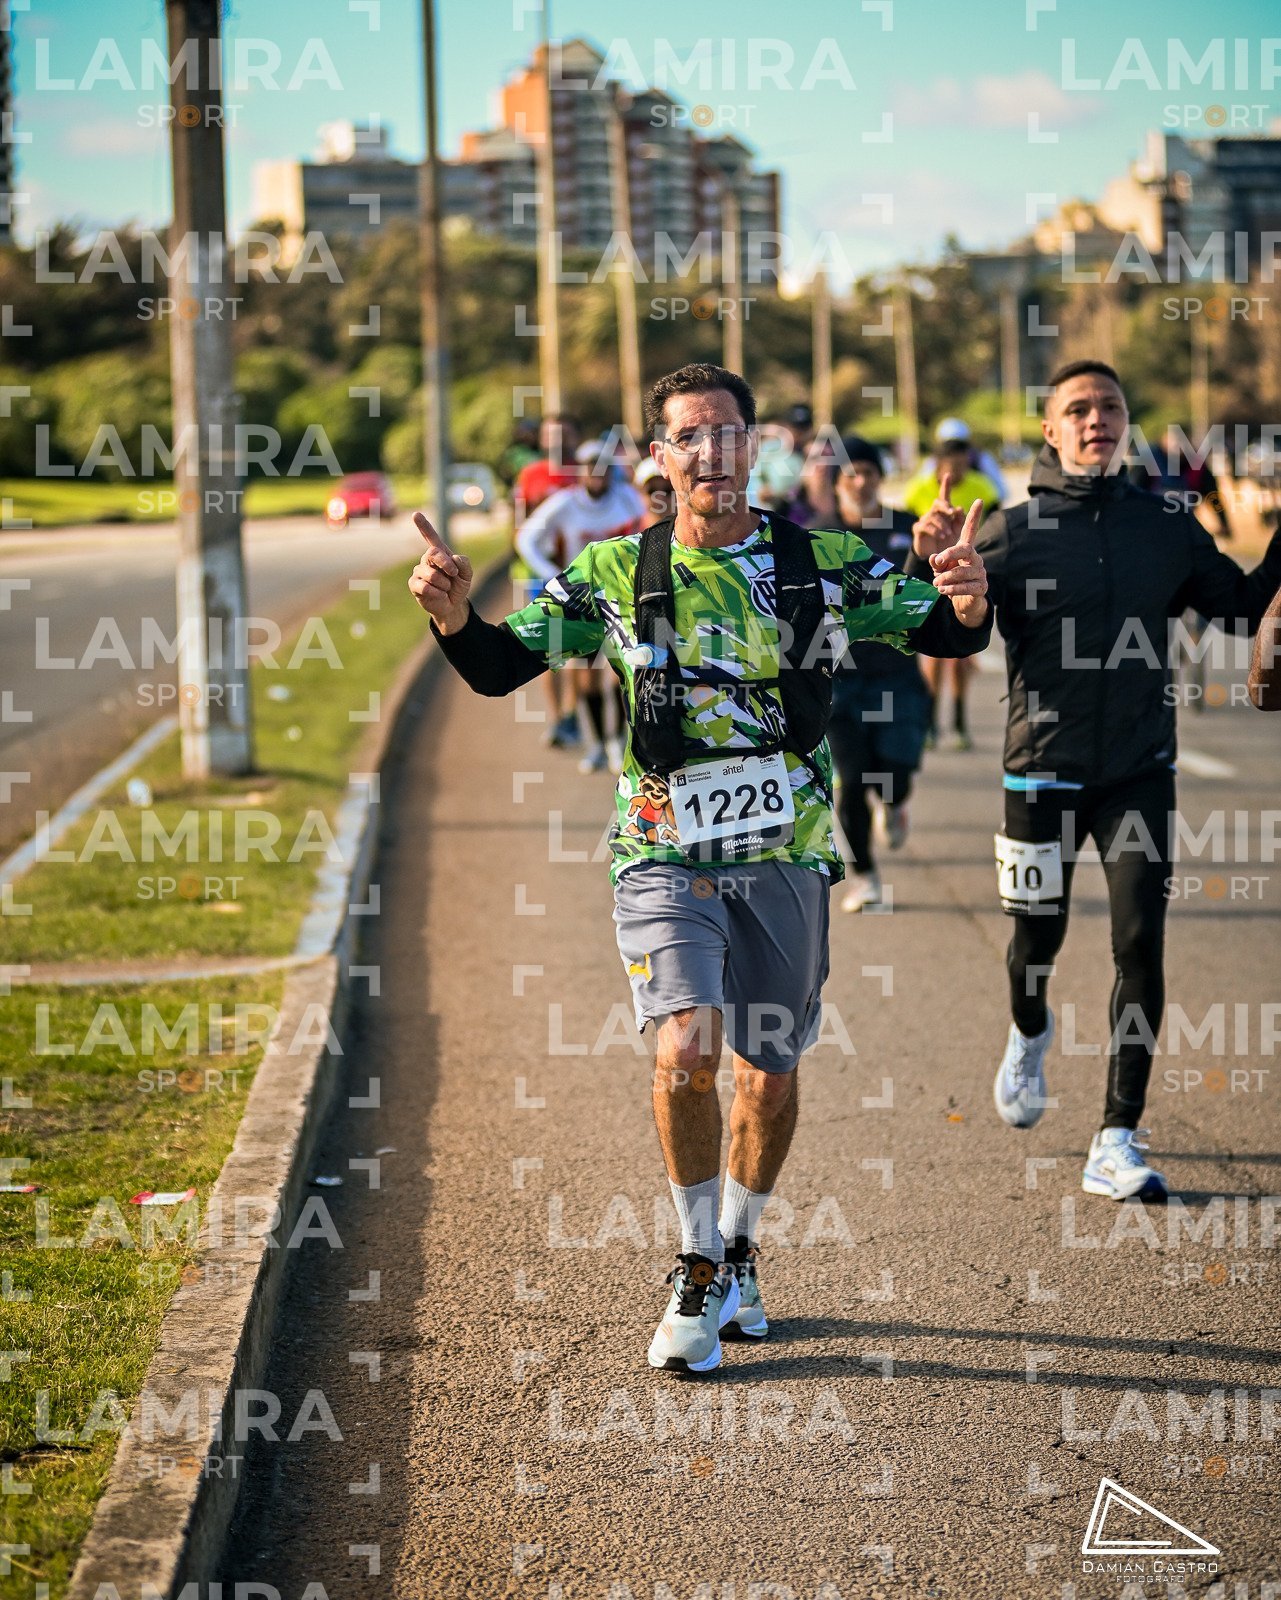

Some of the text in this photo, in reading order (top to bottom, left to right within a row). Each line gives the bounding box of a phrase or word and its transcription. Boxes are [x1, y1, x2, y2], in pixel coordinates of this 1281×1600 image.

[722, 764, 745, 776] antel
[684, 778, 784, 829] 1228
[721, 835, 764, 851] Maratón
